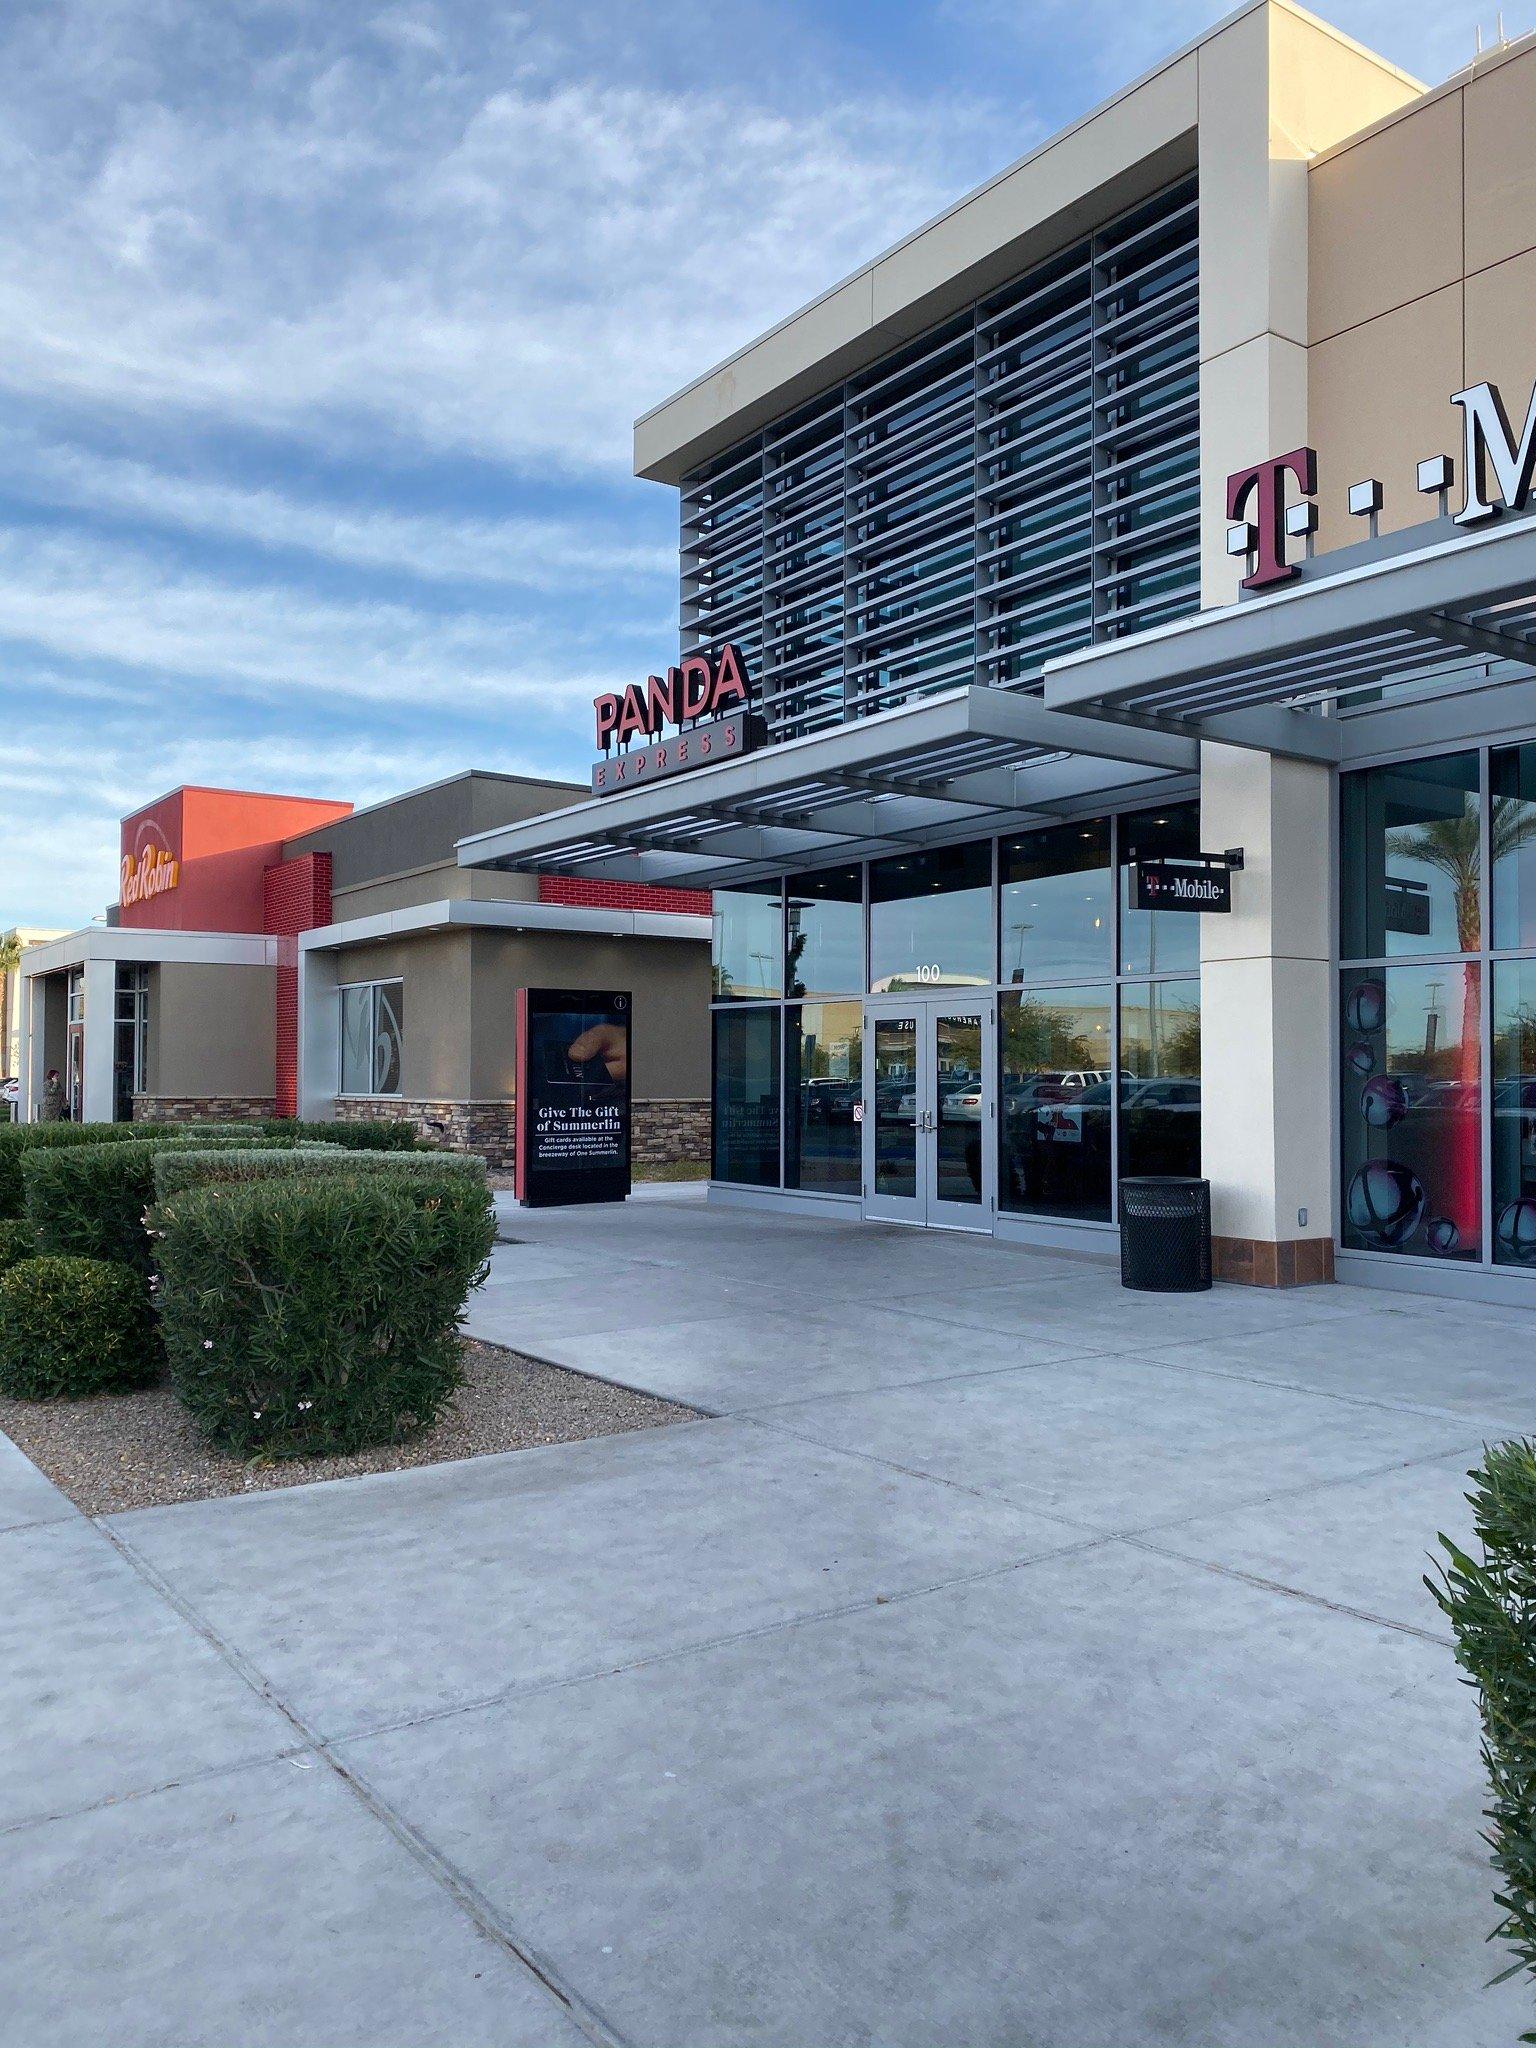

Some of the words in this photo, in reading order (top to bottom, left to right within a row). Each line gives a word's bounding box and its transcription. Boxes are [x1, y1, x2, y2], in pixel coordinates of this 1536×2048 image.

[594, 643, 751, 750] PANDA
[596, 725, 736, 787] EXPRESS
[915, 964, 941, 983] 100
[538, 1107, 567, 1119] Give
[569, 1106, 593, 1118] The
[595, 1106, 620, 1118] Gift
[536, 1120, 551, 1132] of
[553, 1118, 621, 1132] Summerlin
